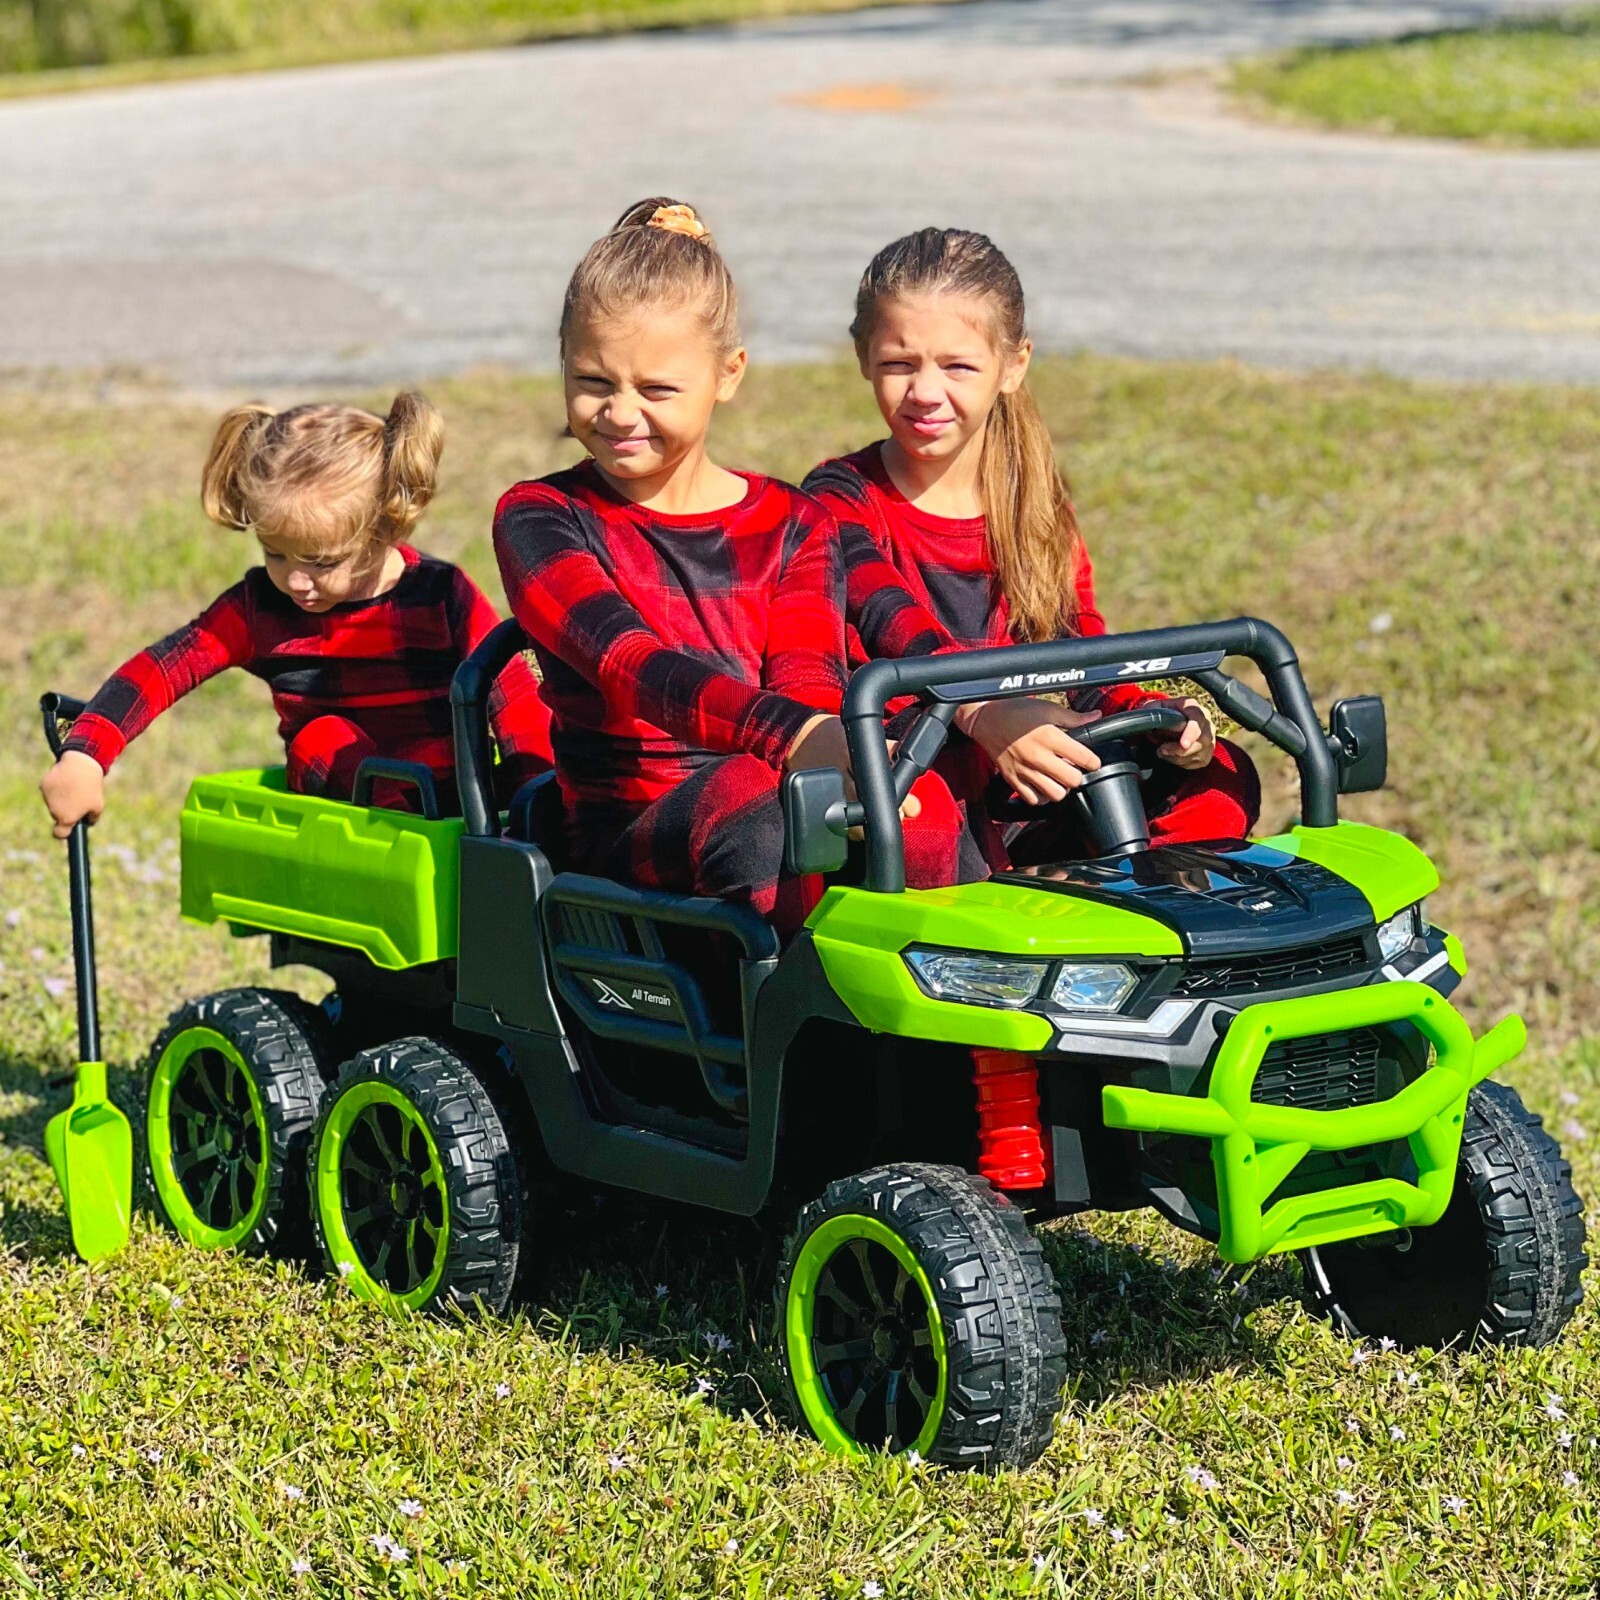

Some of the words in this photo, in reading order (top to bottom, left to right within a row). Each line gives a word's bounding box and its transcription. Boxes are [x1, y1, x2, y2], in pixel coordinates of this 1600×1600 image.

[999, 674, 1023, 690] All
[1026, 668, 1086, 686] Terrain
[1117, 656, 1172, 675] X6
[631, 988, 642, 1001] All
[643, 990, 671, 1006] Terrain
